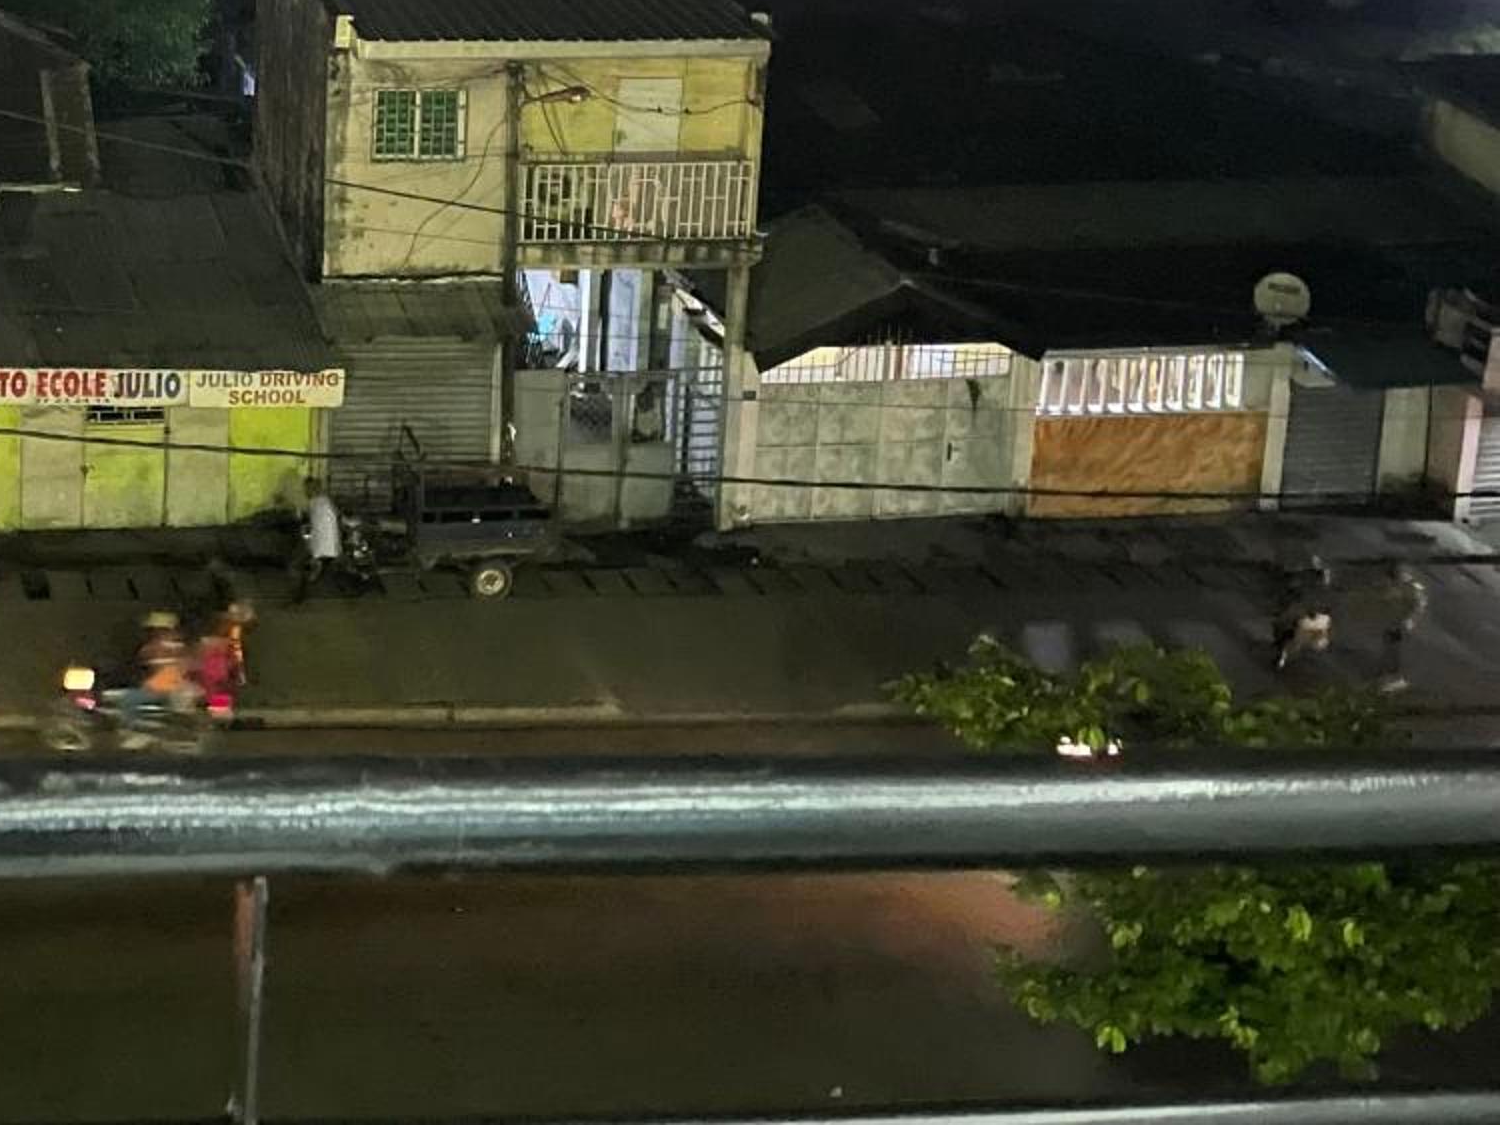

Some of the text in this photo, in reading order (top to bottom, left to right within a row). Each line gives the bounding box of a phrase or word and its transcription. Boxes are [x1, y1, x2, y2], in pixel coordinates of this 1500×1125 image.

[36, 371, 106, 398] ECOLE
[114, 372, 181, 399] JULIO
[196, 372, 339, 387] JULIO DRIVING
[229, 390, 306, 405] SCHOOL
